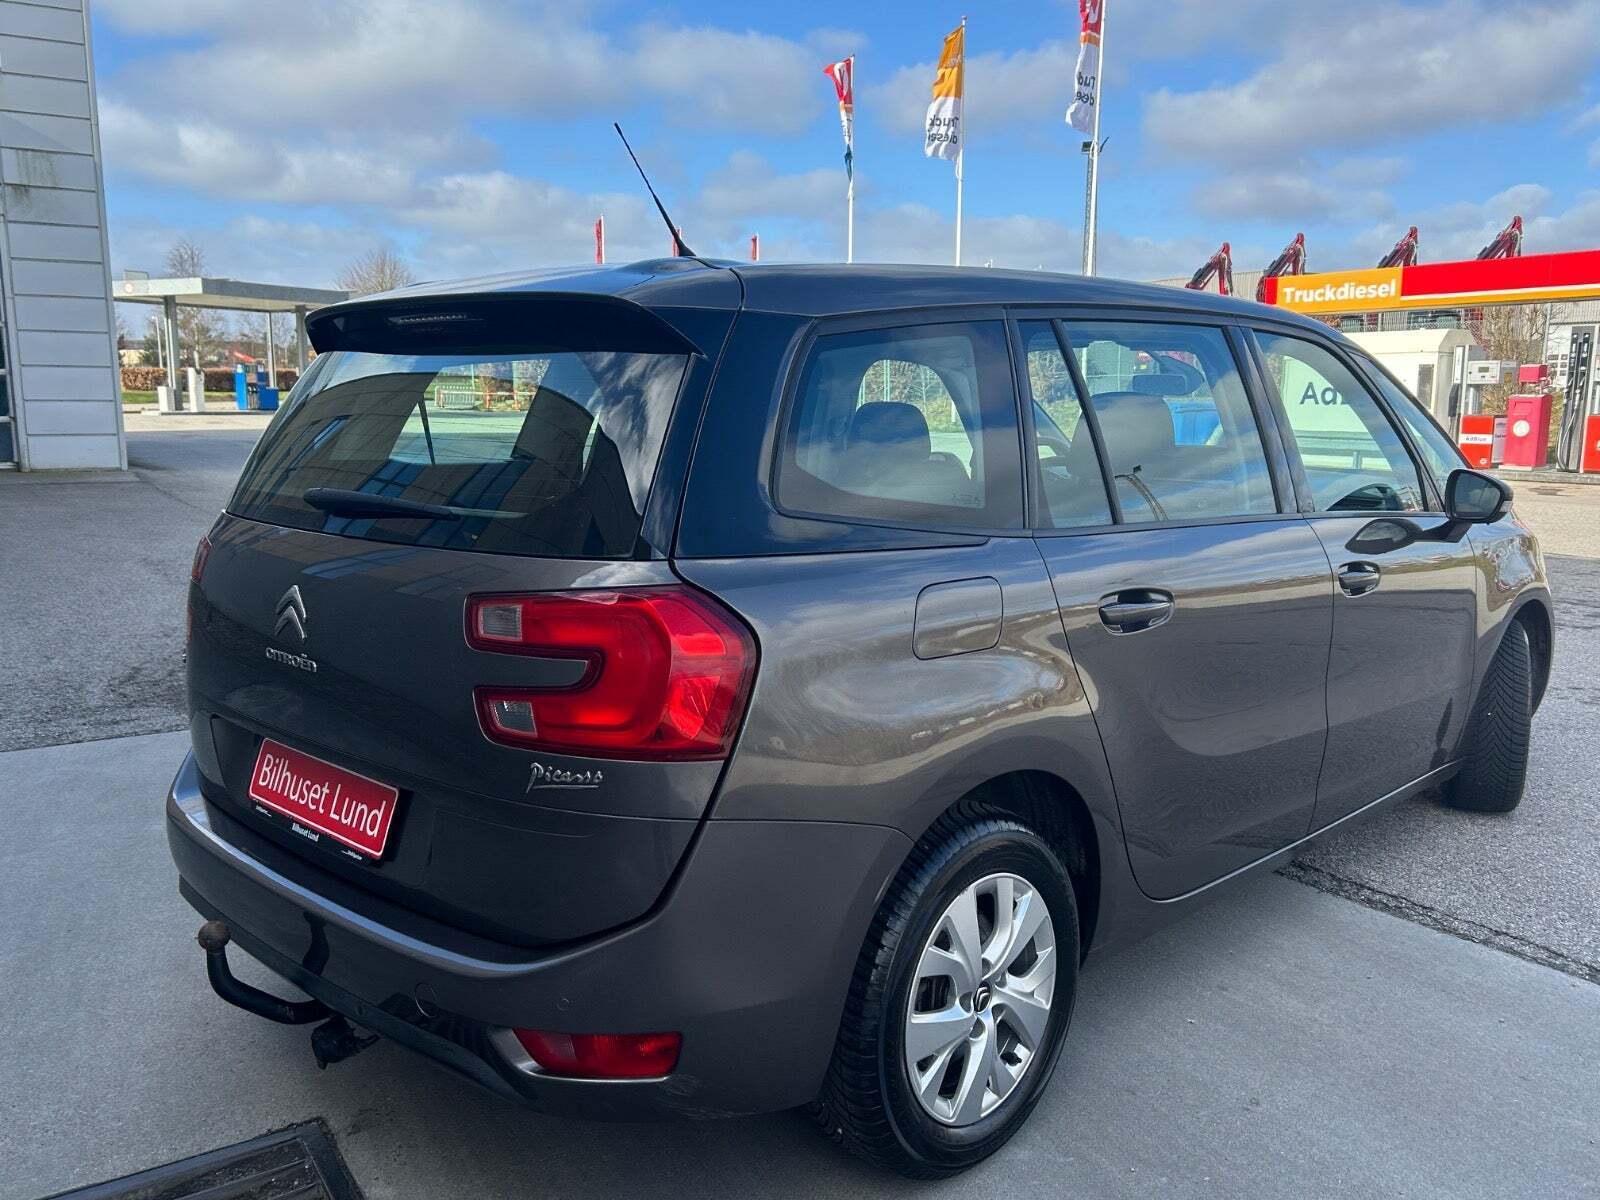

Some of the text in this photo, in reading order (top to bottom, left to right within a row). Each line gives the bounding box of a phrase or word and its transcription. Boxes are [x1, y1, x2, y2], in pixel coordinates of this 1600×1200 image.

[1283, 279, 1397, 303] Truckdiesel
[258, 753, 387, 838] Bilhuset Lund
